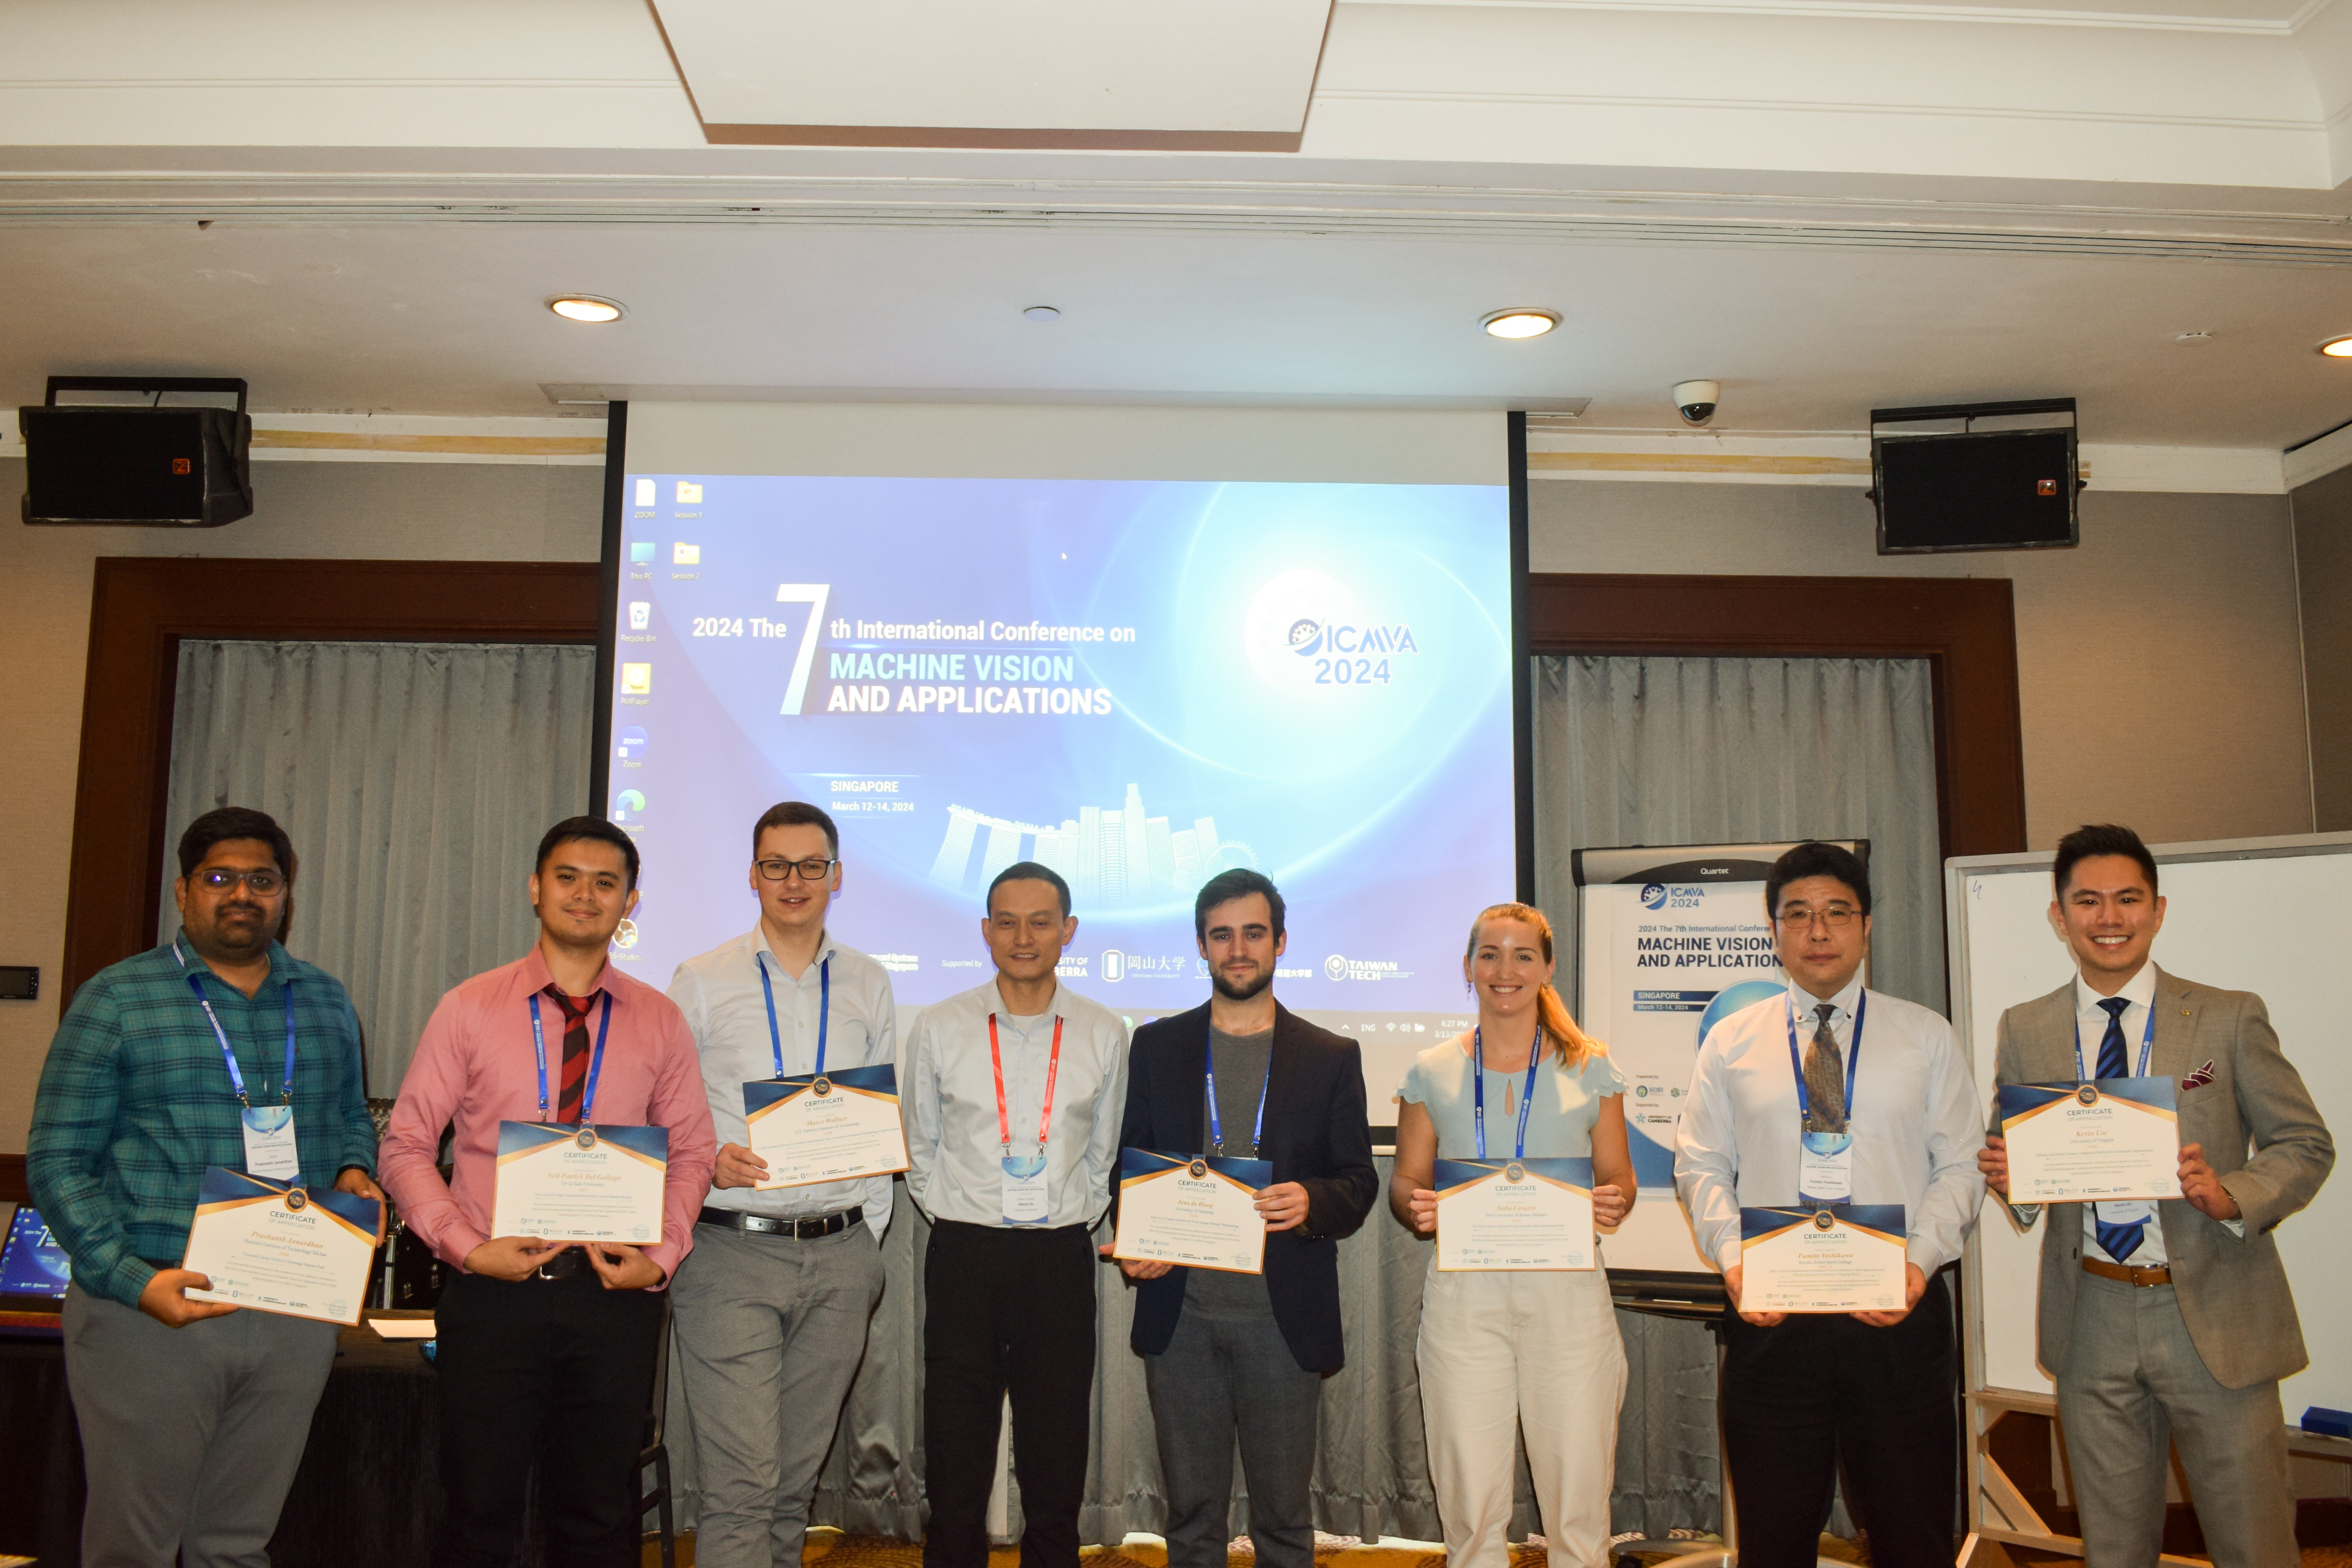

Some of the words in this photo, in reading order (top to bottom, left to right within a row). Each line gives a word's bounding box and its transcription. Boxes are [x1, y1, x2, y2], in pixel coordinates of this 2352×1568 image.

[693, 617, 743, 637] 2024
[749, 617, 786, 637] The
[831, 618, 851, 638] th
[857, 619, 985, 640] International
[991, 621, 1104, 642] Conference
[1110, 627, 1135, 642] on
[1327, 625, 1418, 653] ICMVA
[776, 583, 830, 715] 7
[830, 653, 966, 680] MACHINE
[974, 655, 1074, 681] VISION
[1315, 658, 1391, 685] 2024
[621, 697, 650, 705] PotPlayer
[828, 685, 890, 712] AND
[897, 686, 1112, 715] APPLICATIONS
[831, 780, 899, 792] SINGAPORE
[832, 802, 859, 810] March
[862, 802, 890, 812] 12-14,
[892, 802, 914, 811] 2024
[1671, 887, 1705, 897] ICMVA
[1671, 899, 1699, 907] 2024
[1638, 937, 1712, 951] MACHINE
[1716, 937, 1773, 951] VISION
[942, 959, 972, 969] Supported
[974, 960, 982, 969] by
[1128, 955, 1186, 970] 岡山大学
[1348, 960, 1397, 971] TAIWAN
[1637, 954, 1670, 968] AND
[1675, 954, 1784, 968] APPLICATION
[1054, 967, 1088, 977] BERRA
[1348, 970, 1381, 980] TECH
[804, 1096, 844, 1107] CERTIFICATE
[1178, 1180, 1217, 1189] CERTIFICATE
[1198, 1201, 1214, 1209] Hoog
[270, 1211, 317, 1224] CERTIFICATE
[277, 1219, 315, 1230] APPRECIATION
[252, 1231, 286, 1242] Prashanth
[287, 1237, 324, 1249] Janardhan
[286, 1246, 312, 1256] Technology
